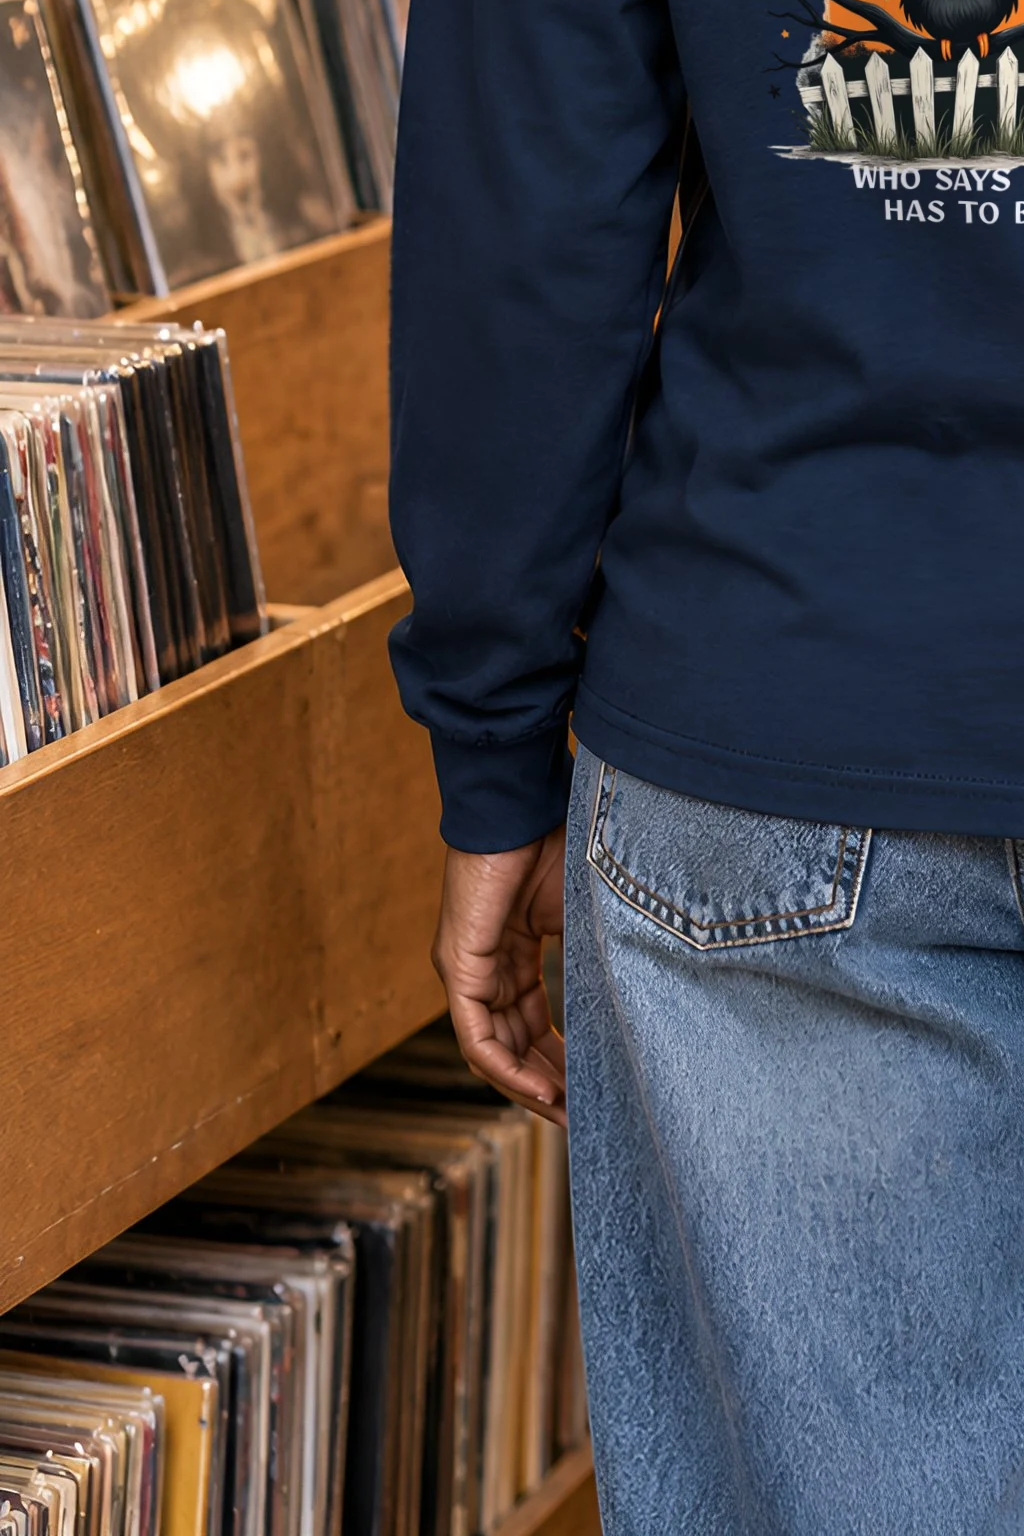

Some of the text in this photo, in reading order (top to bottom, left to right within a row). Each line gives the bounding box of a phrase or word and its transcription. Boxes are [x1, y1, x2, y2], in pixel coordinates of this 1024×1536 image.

[852, 165, 921, 191] WHO
[935, 168, 1011, 193] SAYS
[884, 199, 945, 223] HAS
[957, 200, 1000, 225] TO
